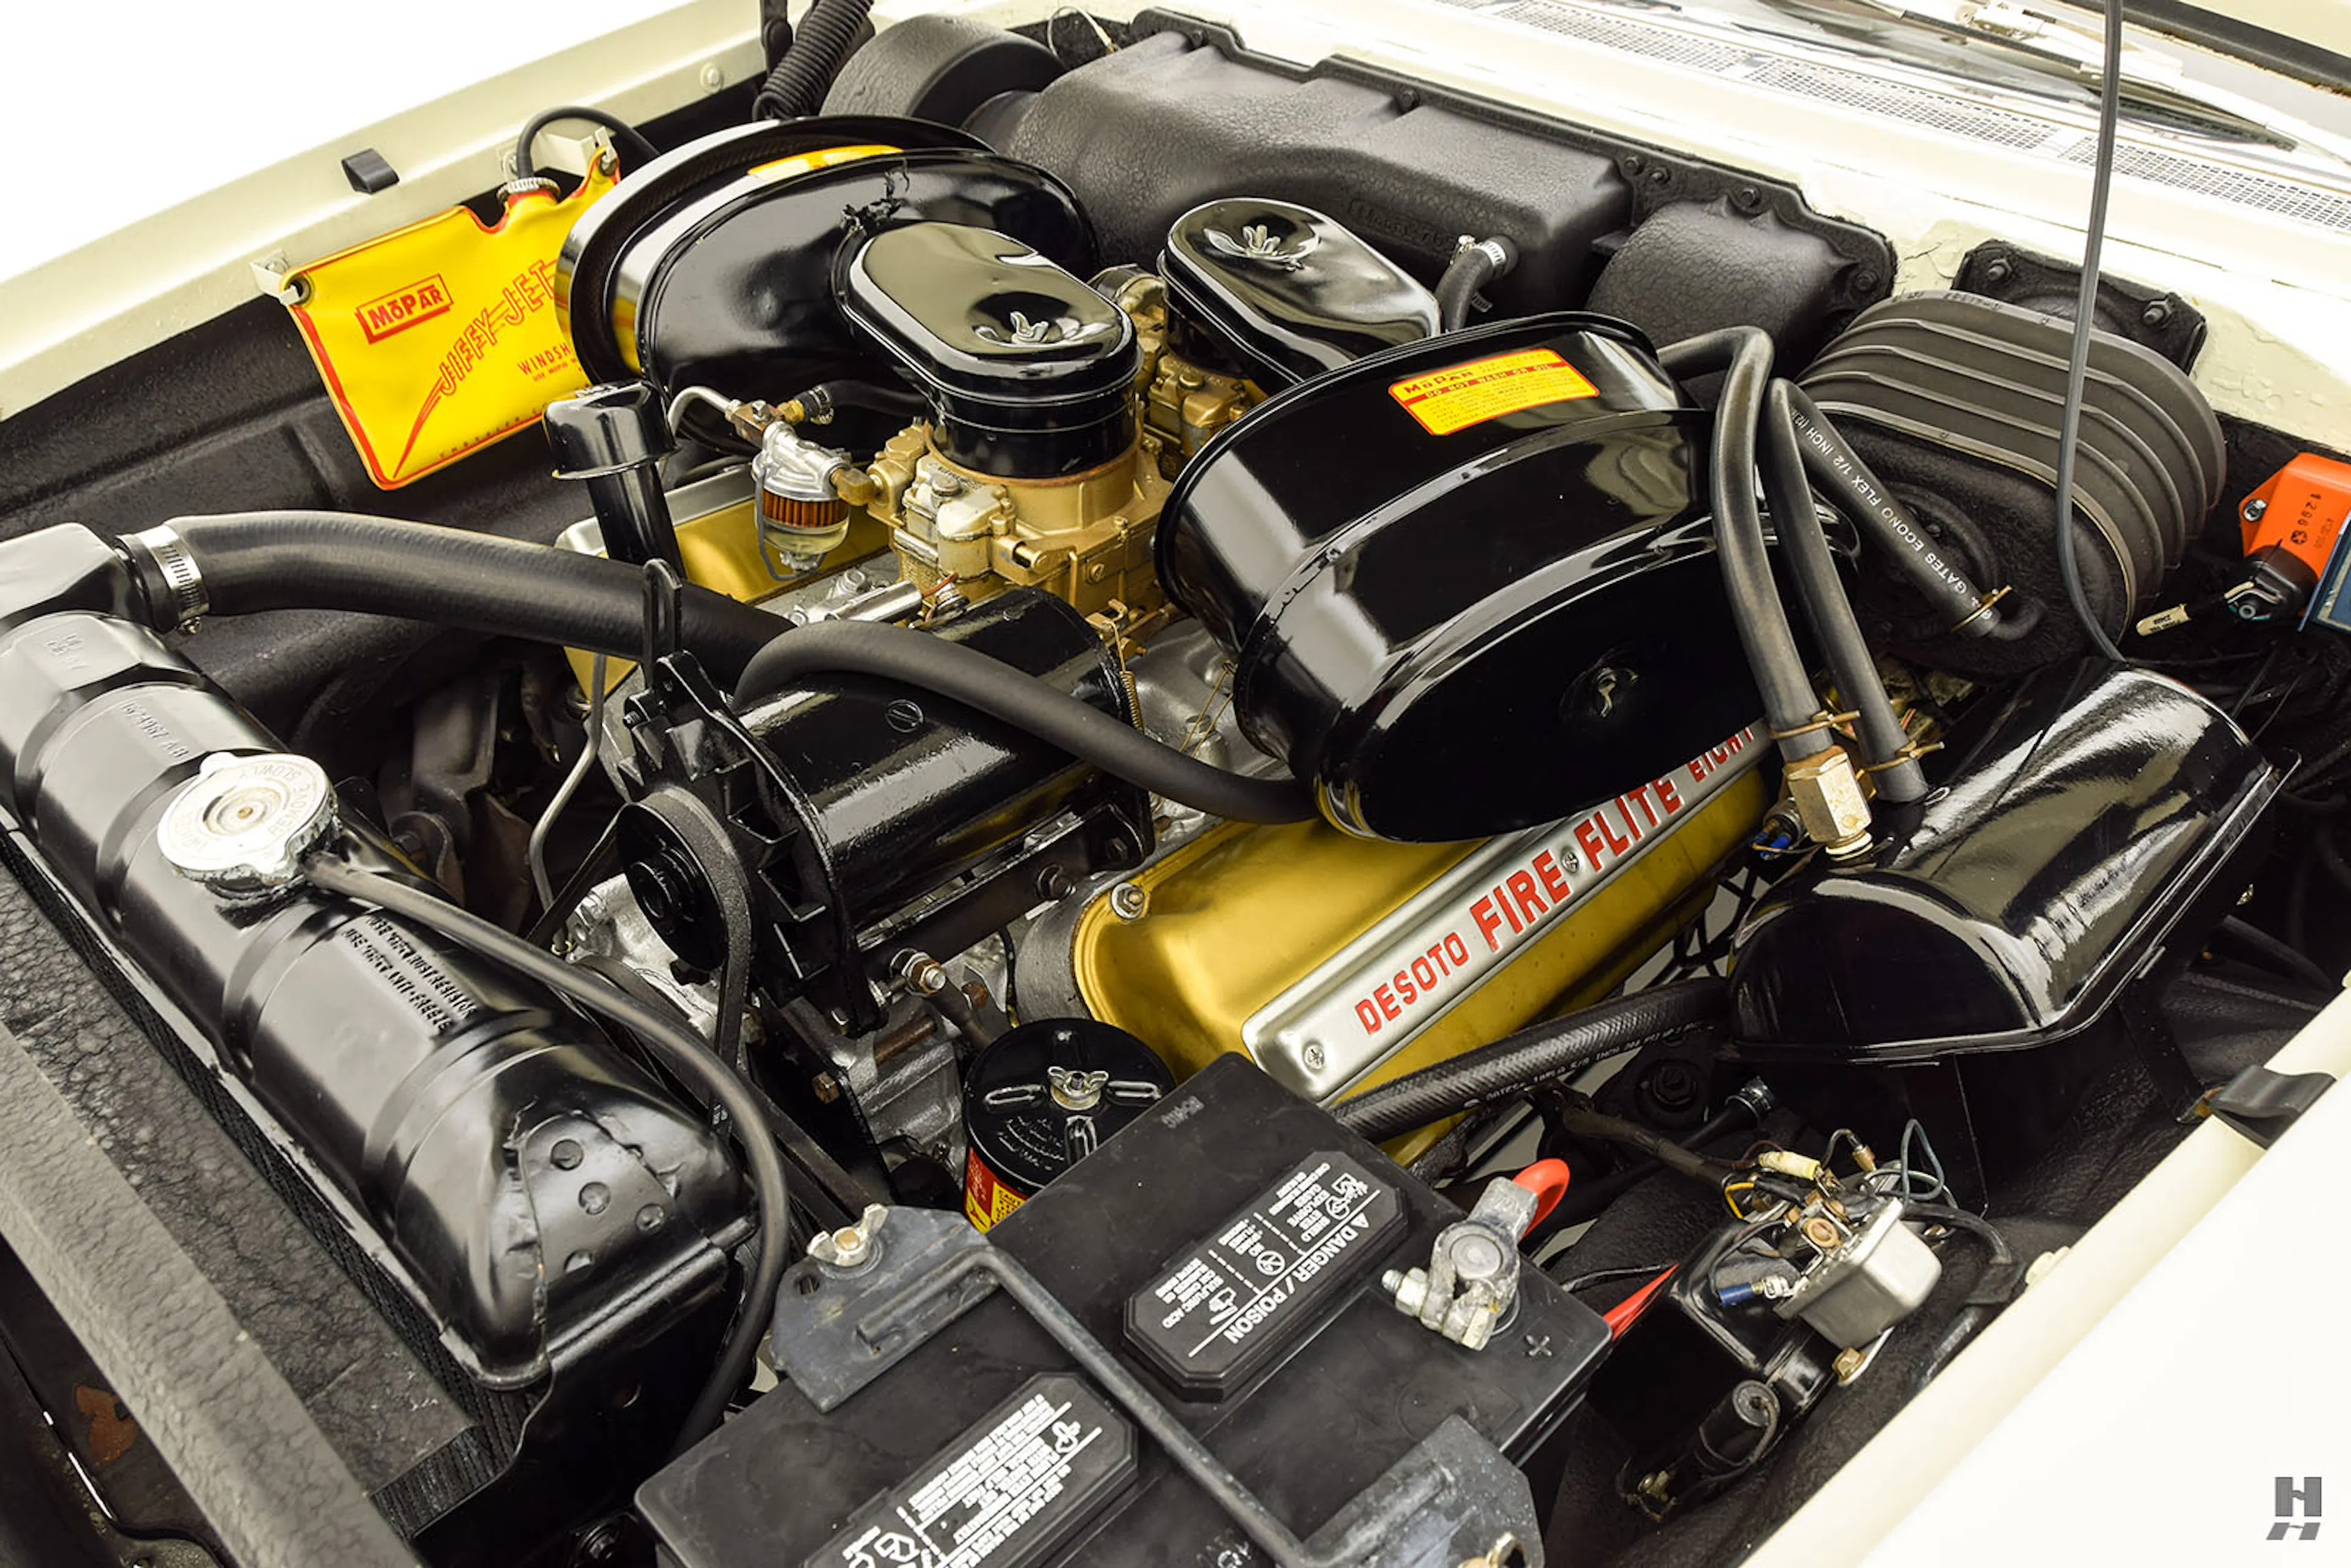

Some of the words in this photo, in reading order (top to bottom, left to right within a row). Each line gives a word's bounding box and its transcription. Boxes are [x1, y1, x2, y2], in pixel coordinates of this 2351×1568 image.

[438, 309, 498, 396] JIFFY
[501, 260, 557, 326] JET
[1804, 425, 1835, 456] INCH
[1831, 453, 1853, 476] 1/2
[1850, 473, 1883, 507] FLEX
[1879, 505, 1925, 552] ECONO
[1923, 549, 1970, 596] GATES
[1355, 932, 1470, 1034] DESOTO
[1470, 849, 1573, 951] FIRE
[1574, 776, 1682, 871] FLITE
[1290, 1223, 1360, 1285] DANGER
[1160, 1307, 1186, 1330] ACID
[1221, 1285, 1289, 1345] POISON
